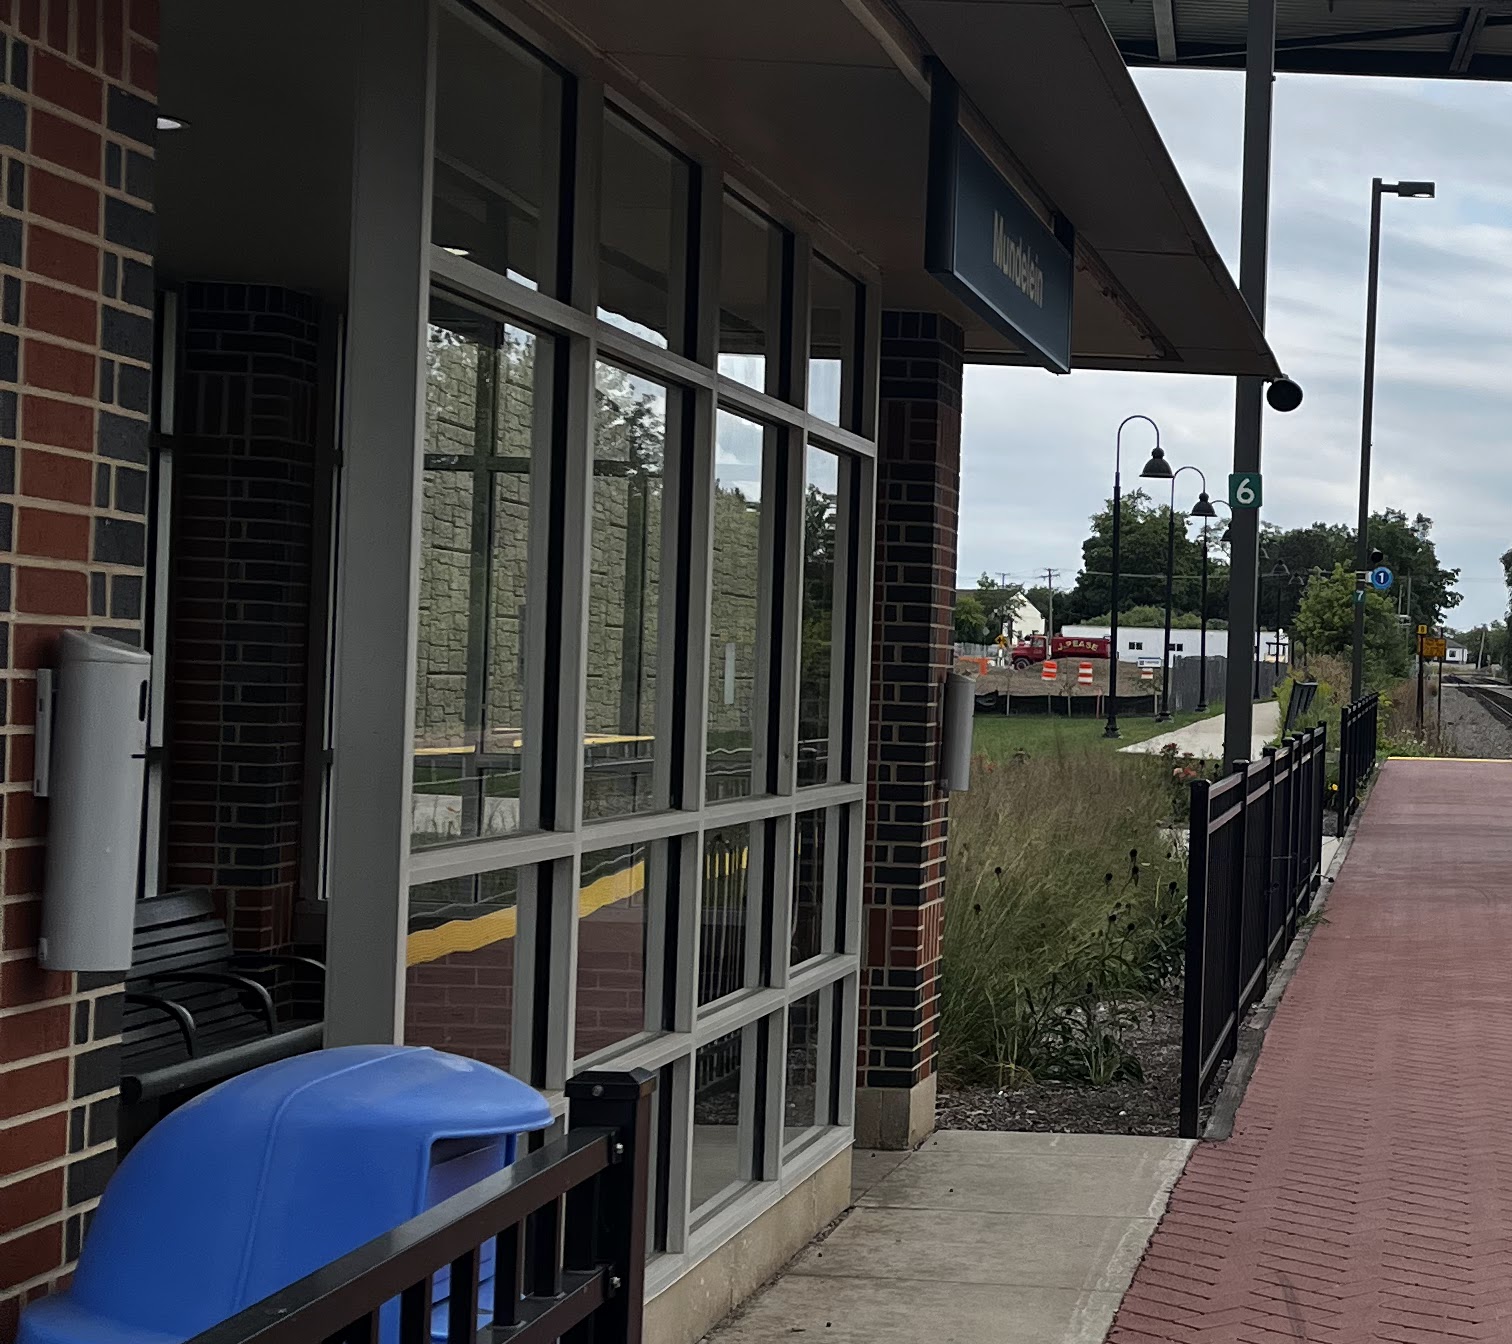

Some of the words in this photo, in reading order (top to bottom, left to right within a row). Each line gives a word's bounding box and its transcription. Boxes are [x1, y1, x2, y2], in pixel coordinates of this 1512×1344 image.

[992, 210, 1044, 308] Mundelein
[1236, 478, 1256, 504] 6
[1356, 590, 1364, 601] 7
